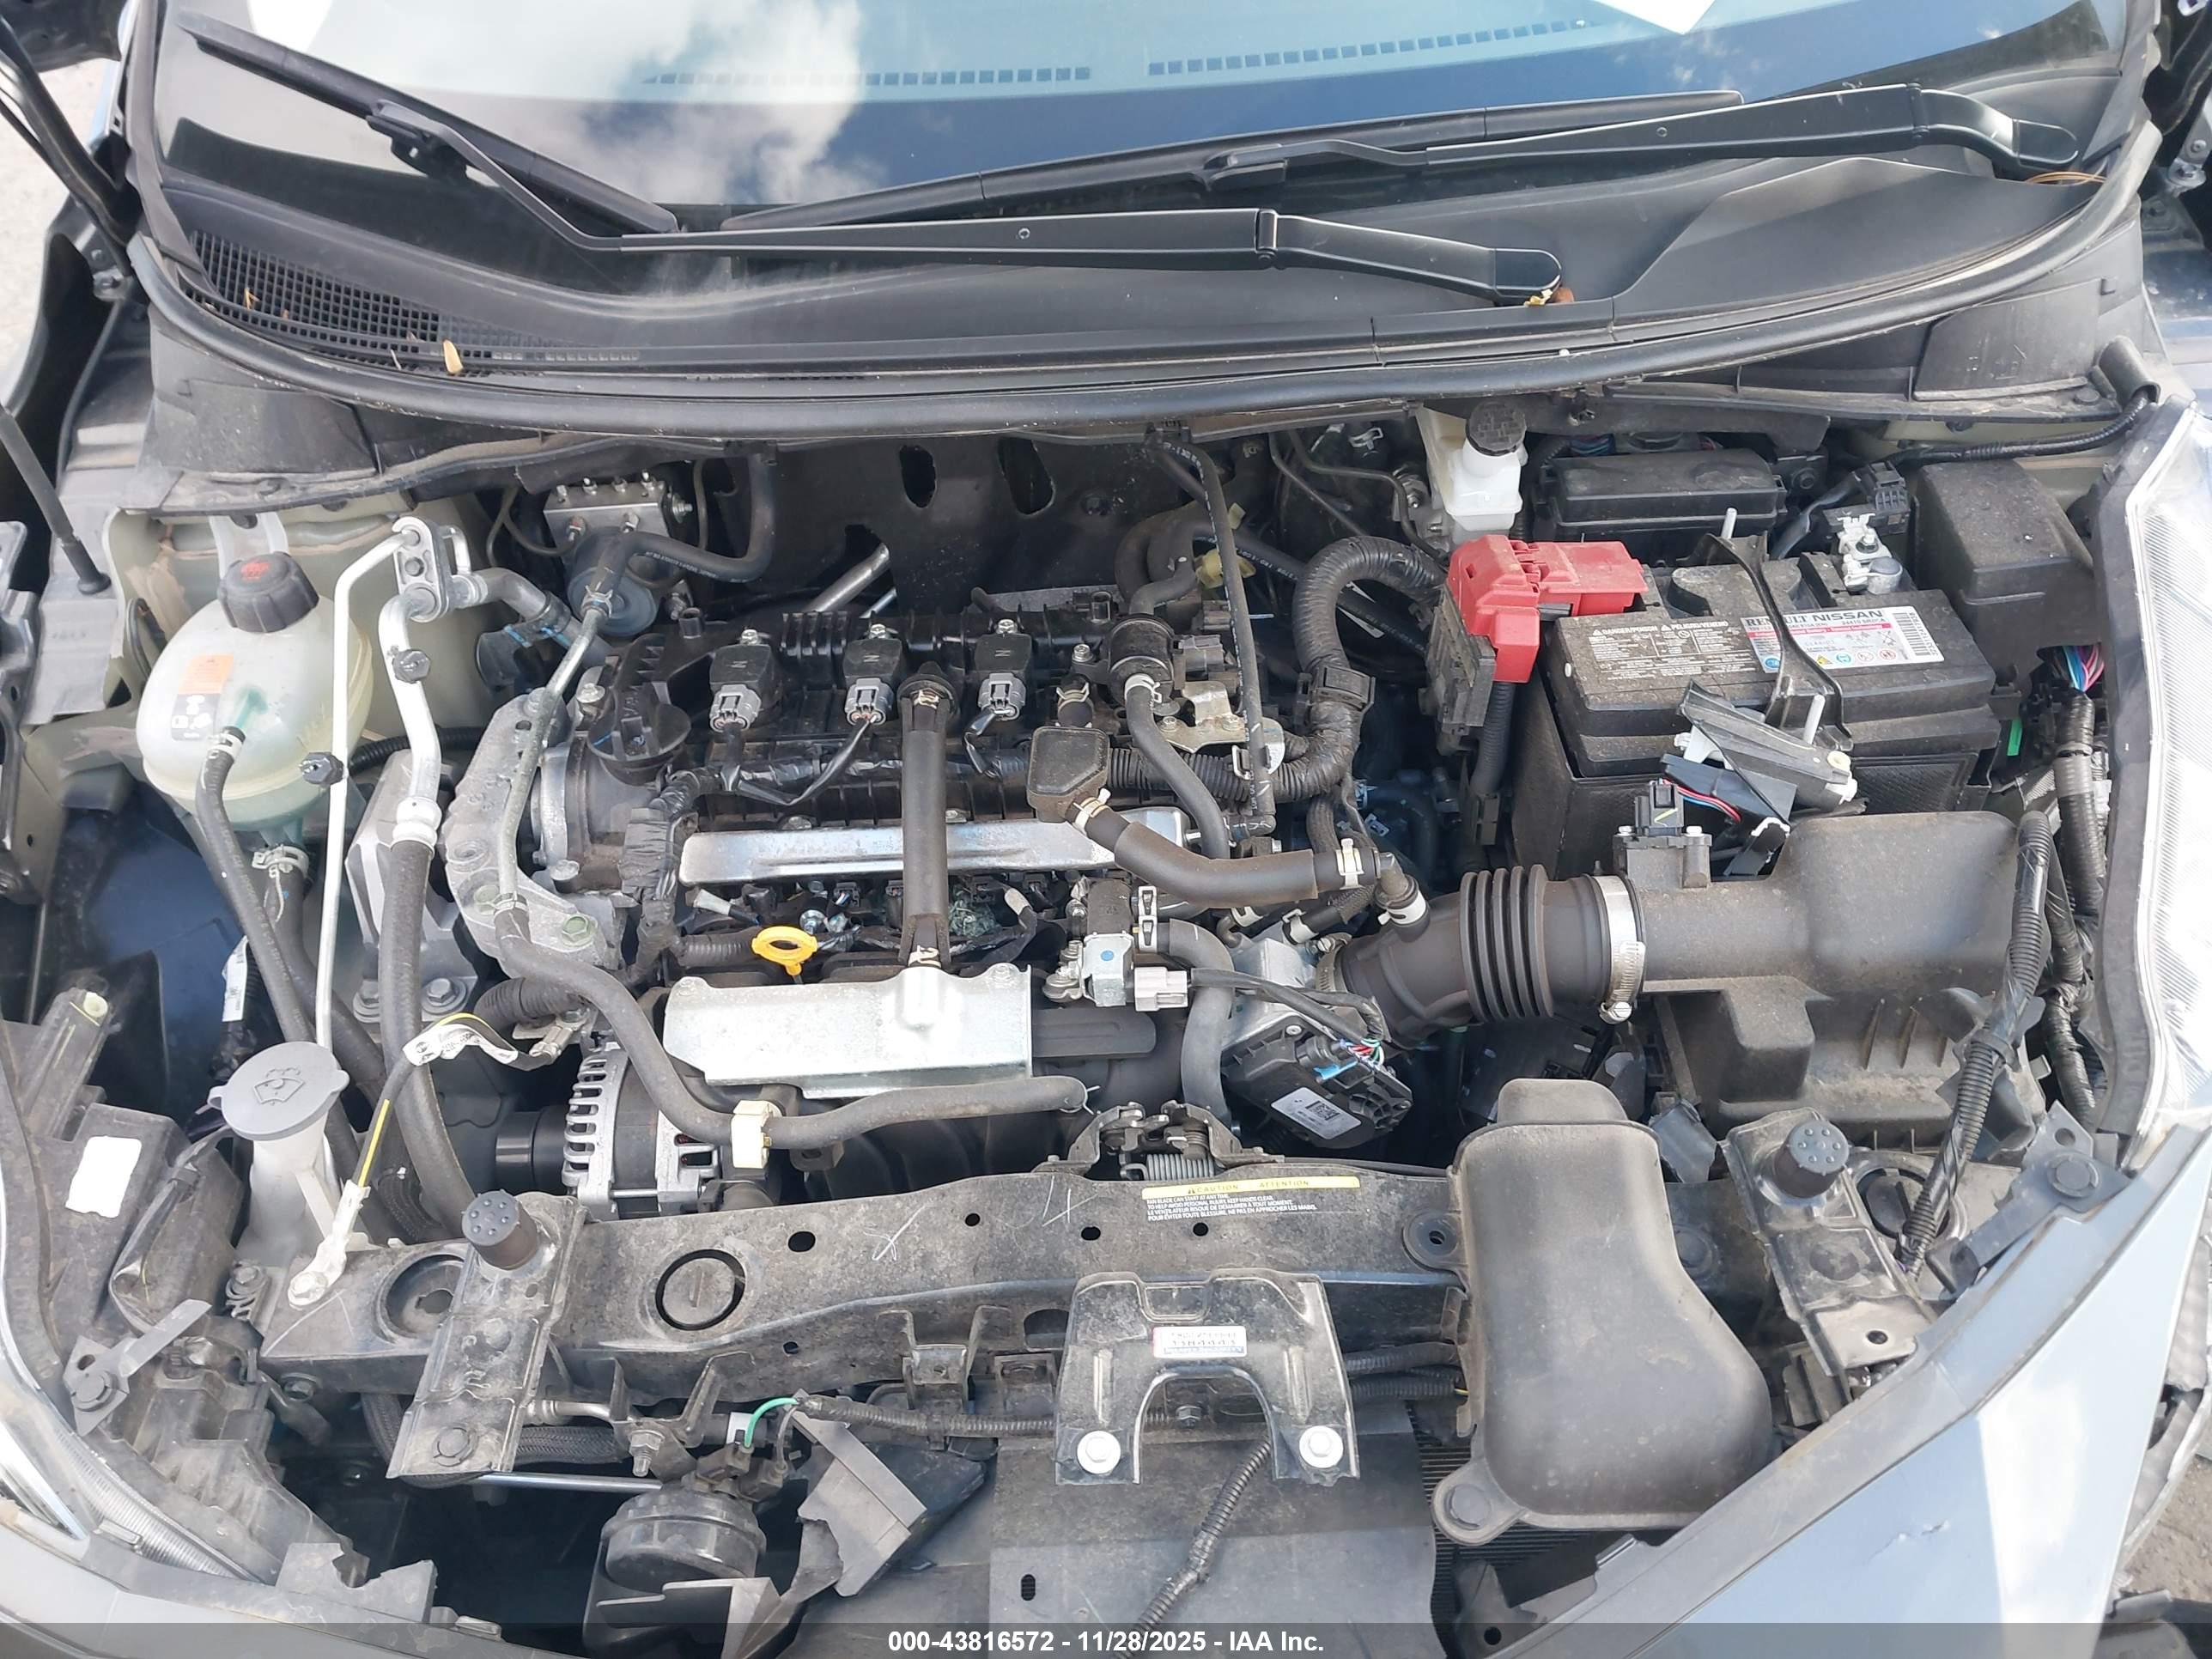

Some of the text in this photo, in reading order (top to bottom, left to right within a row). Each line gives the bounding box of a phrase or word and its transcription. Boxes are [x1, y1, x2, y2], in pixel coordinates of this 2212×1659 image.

[1746, 615, 1808, 627] RENULT
[1813, 610, 1883, 622] NISSAN
[1197, 1184, 1238, 1193] CAUTION
